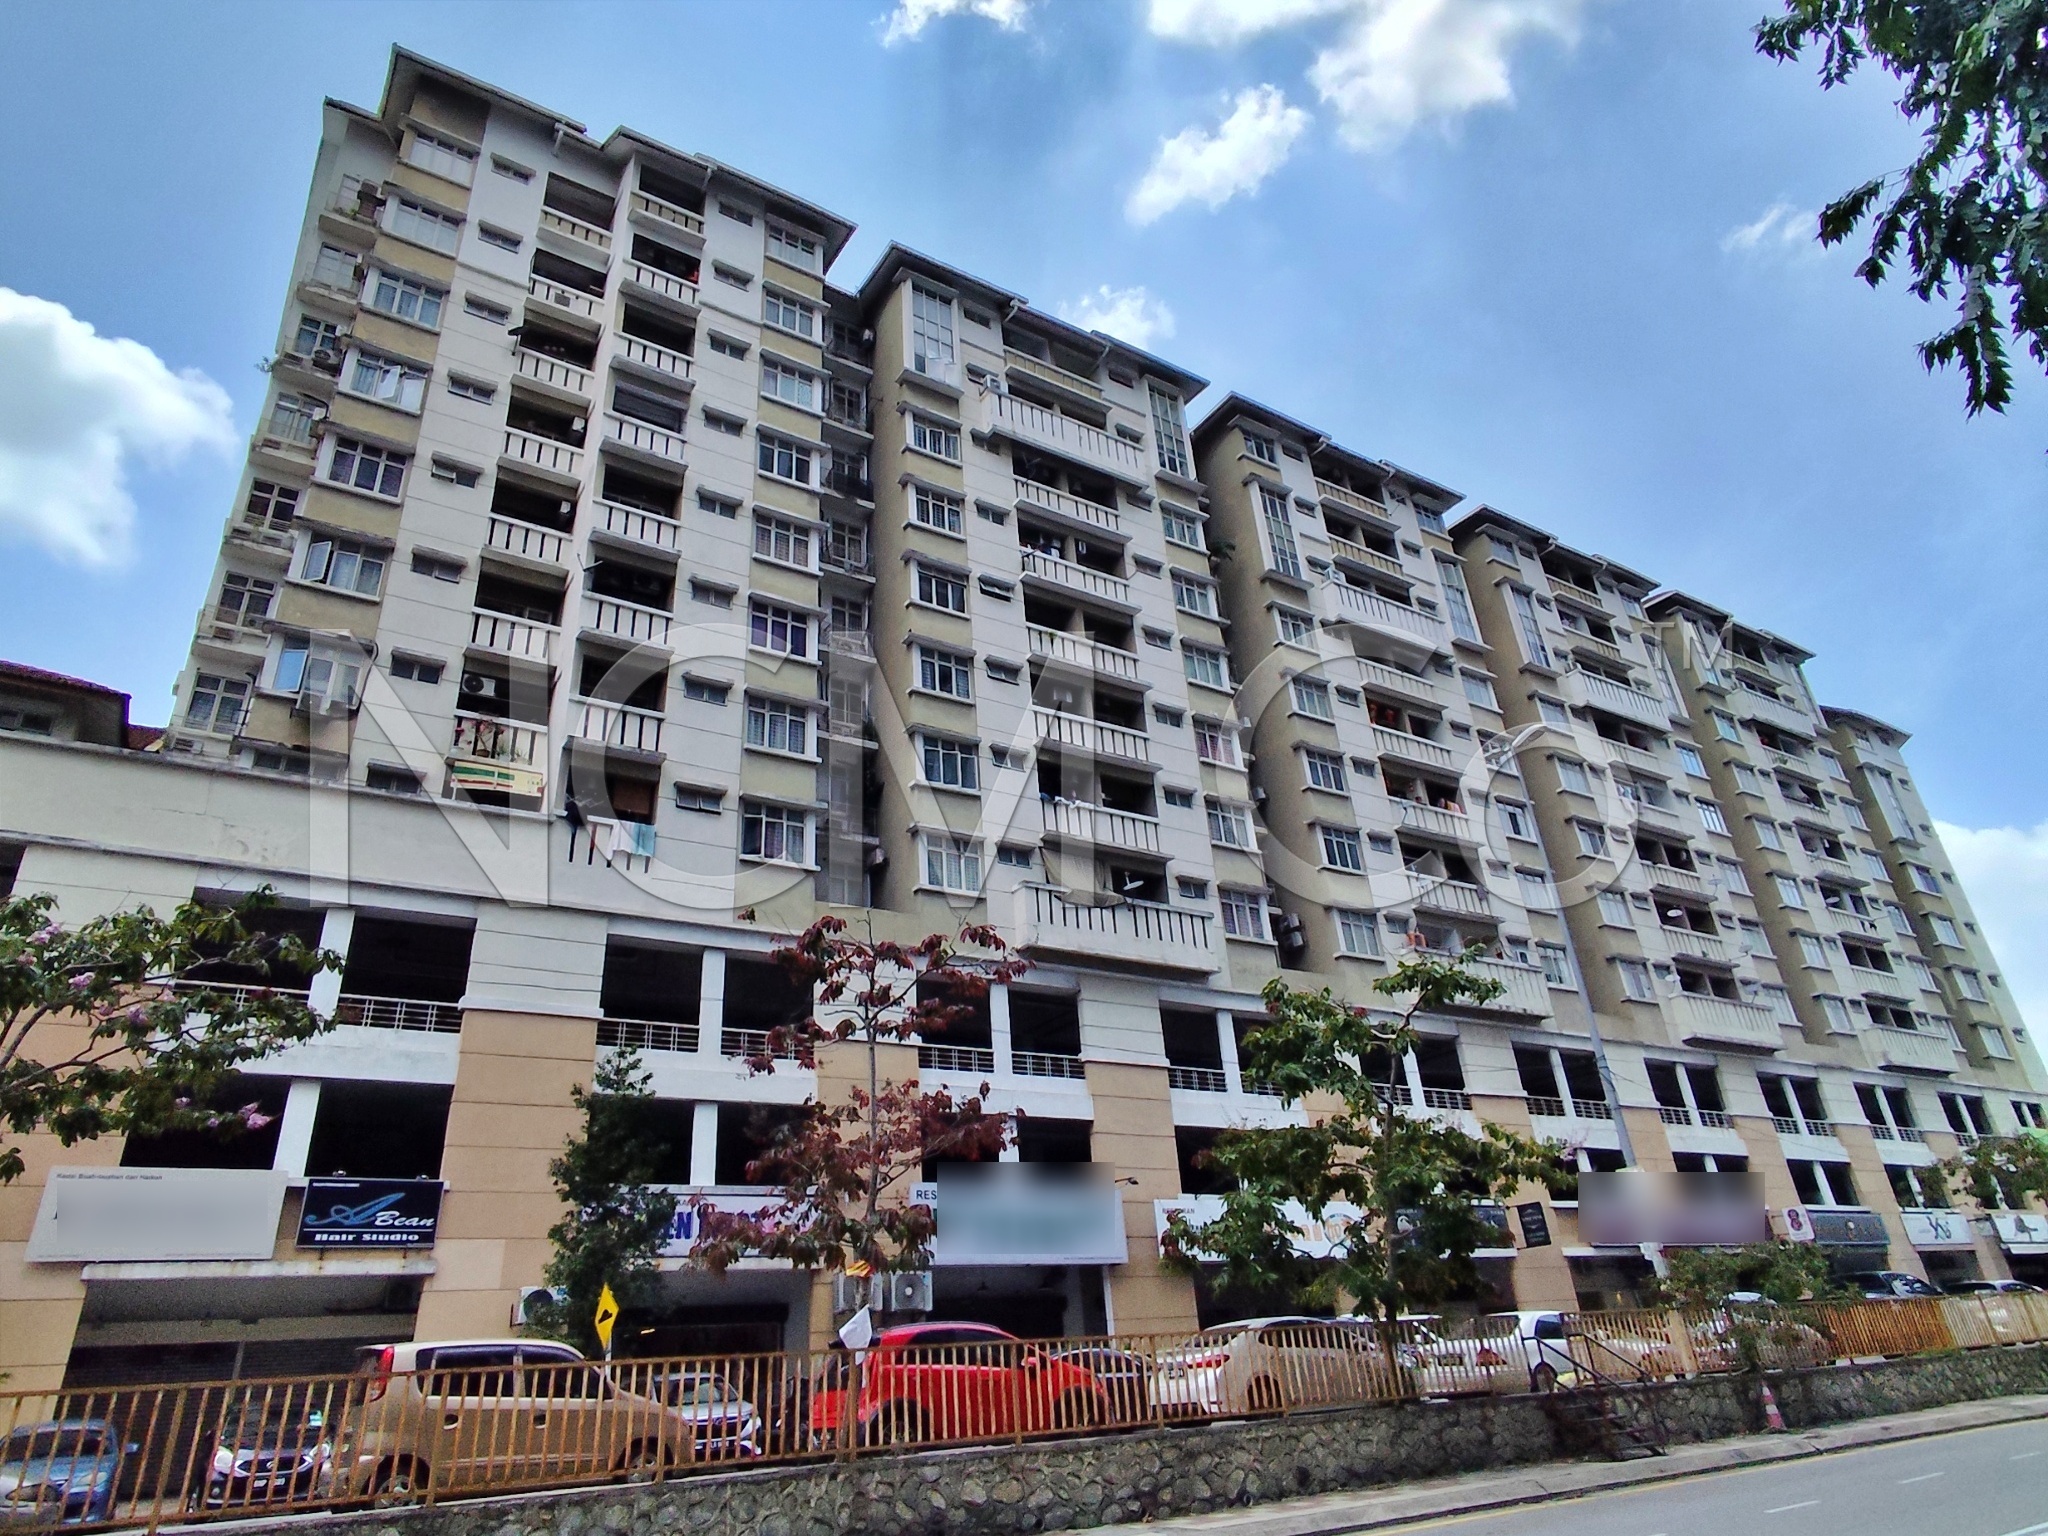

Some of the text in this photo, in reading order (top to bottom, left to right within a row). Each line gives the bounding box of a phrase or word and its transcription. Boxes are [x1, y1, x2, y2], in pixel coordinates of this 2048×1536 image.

[374, 1210, 435, 1227] Bean
[314, 1233, 419, 1242] Hair Studio
